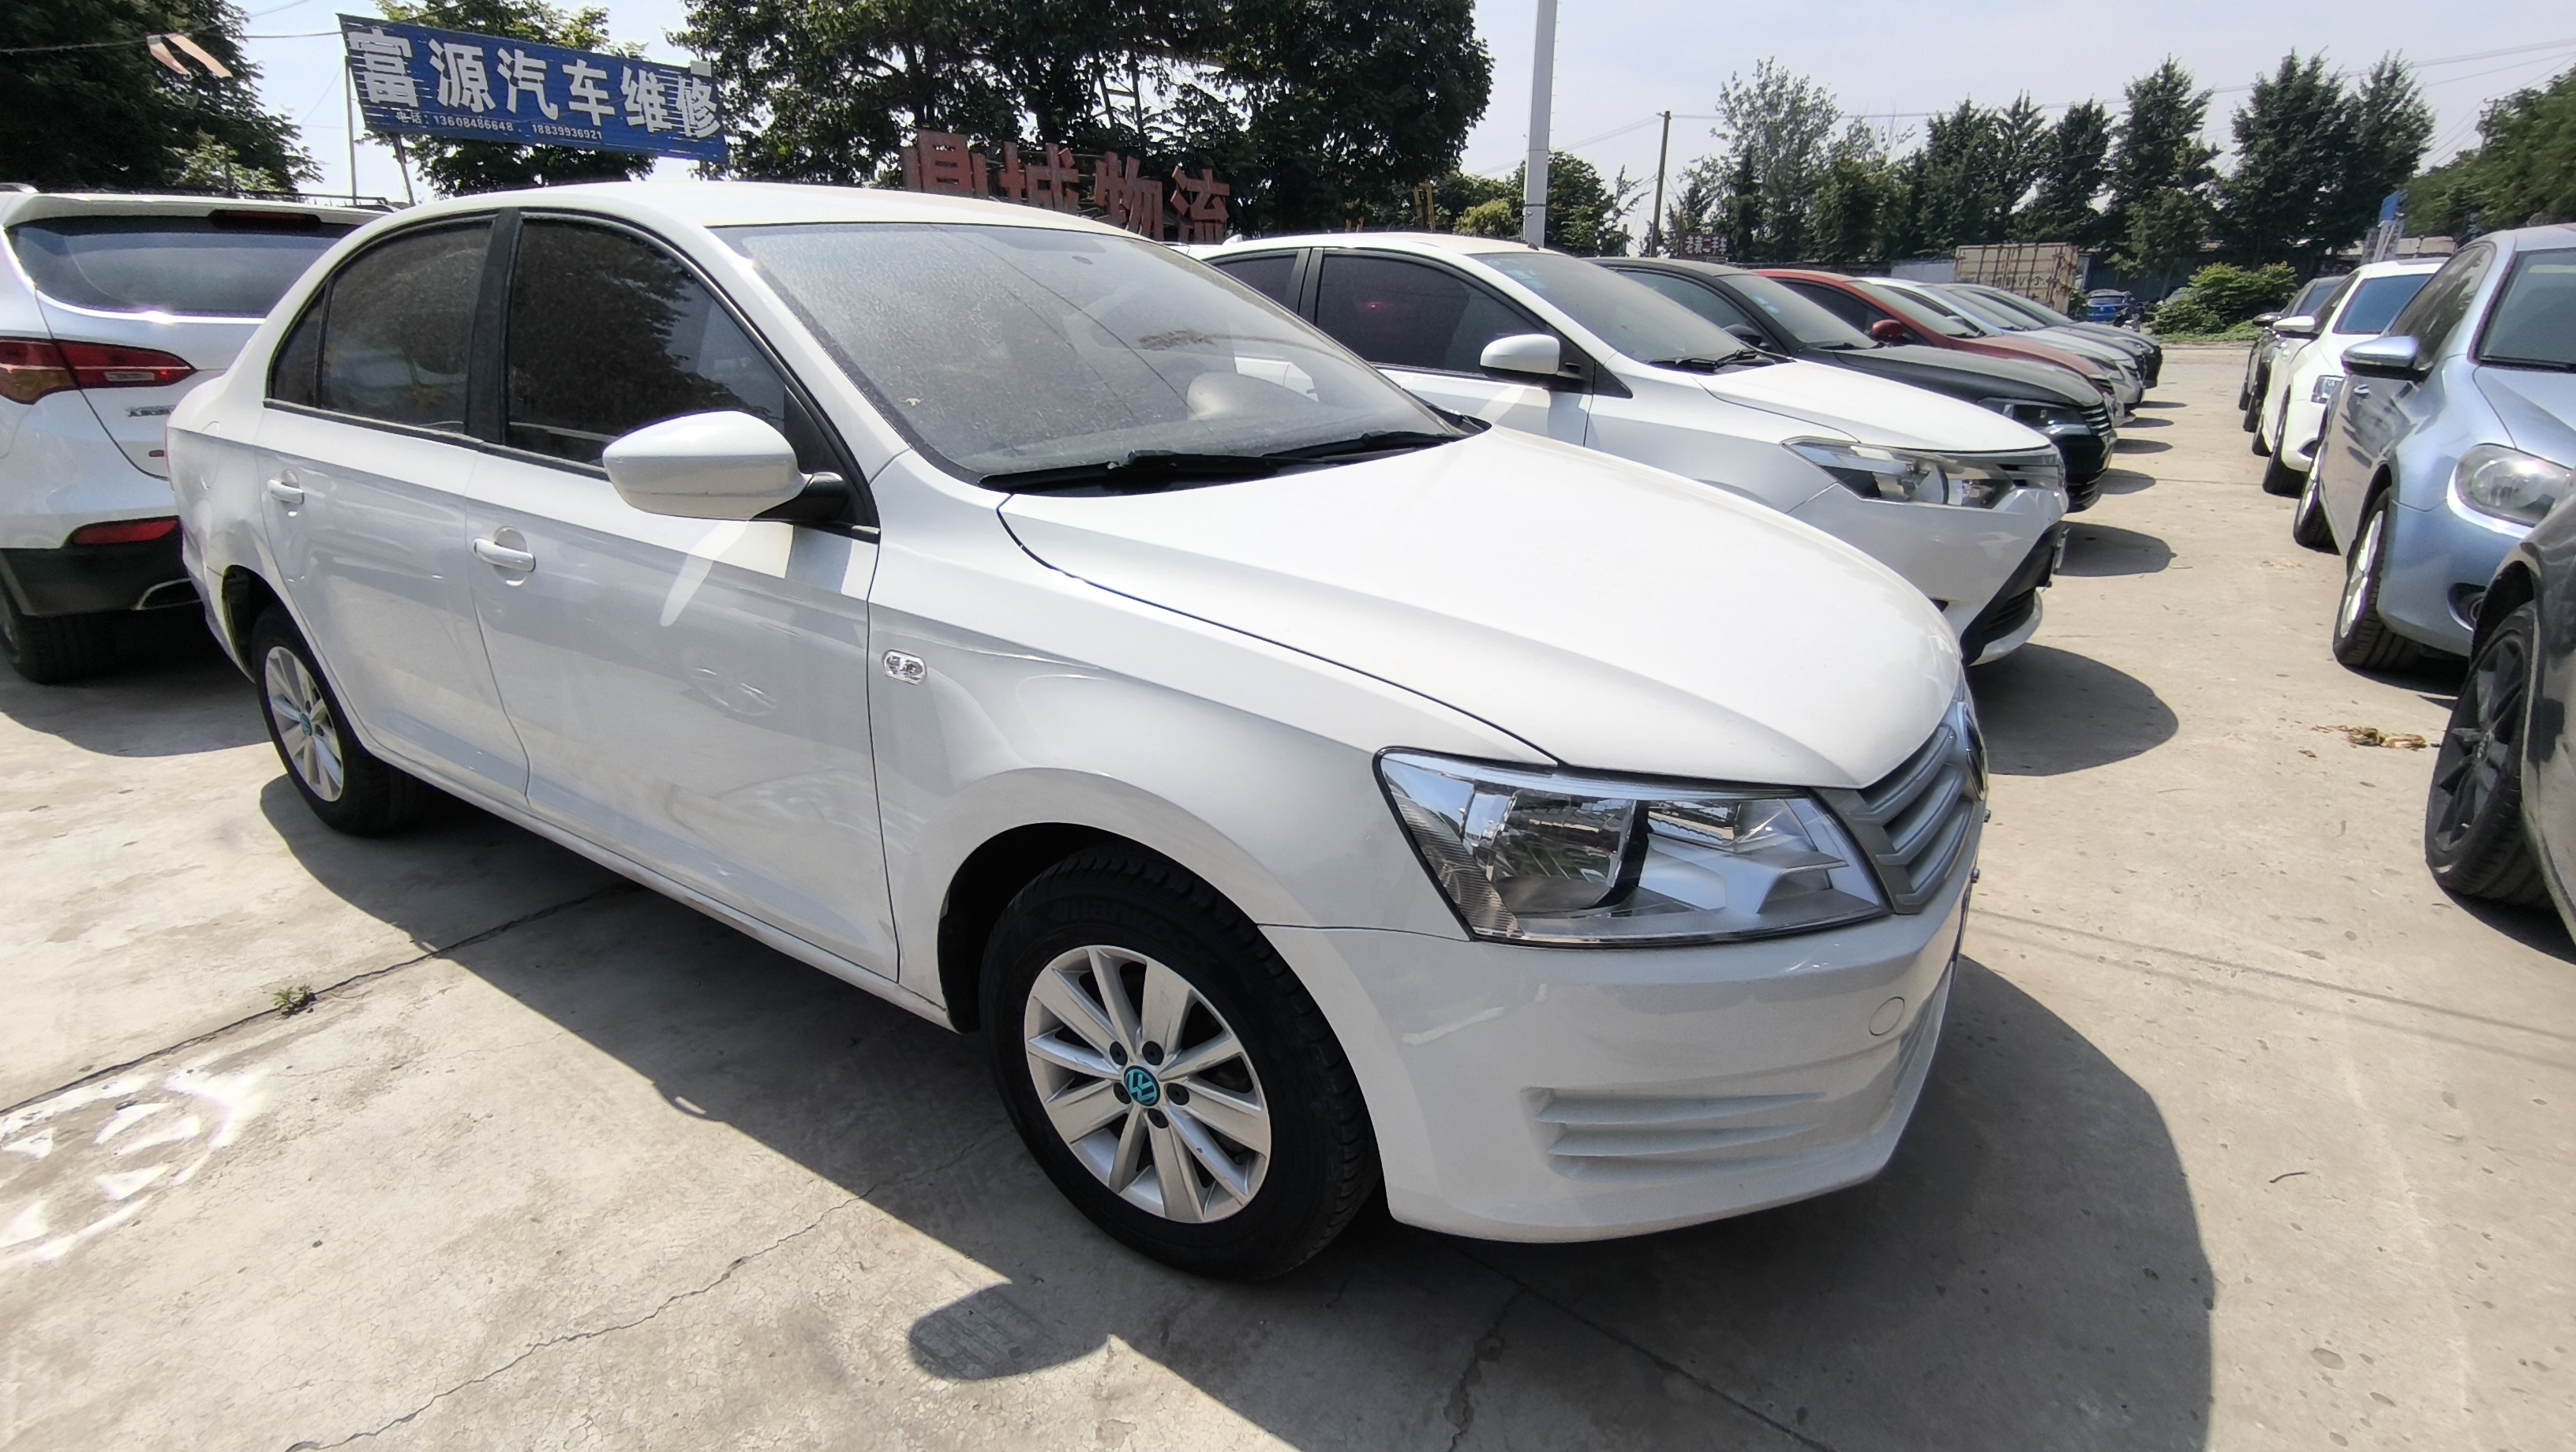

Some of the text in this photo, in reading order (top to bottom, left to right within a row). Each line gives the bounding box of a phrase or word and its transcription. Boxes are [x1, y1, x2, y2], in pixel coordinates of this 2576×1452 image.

[347, 28, 721, 139] 富源汽车维修
